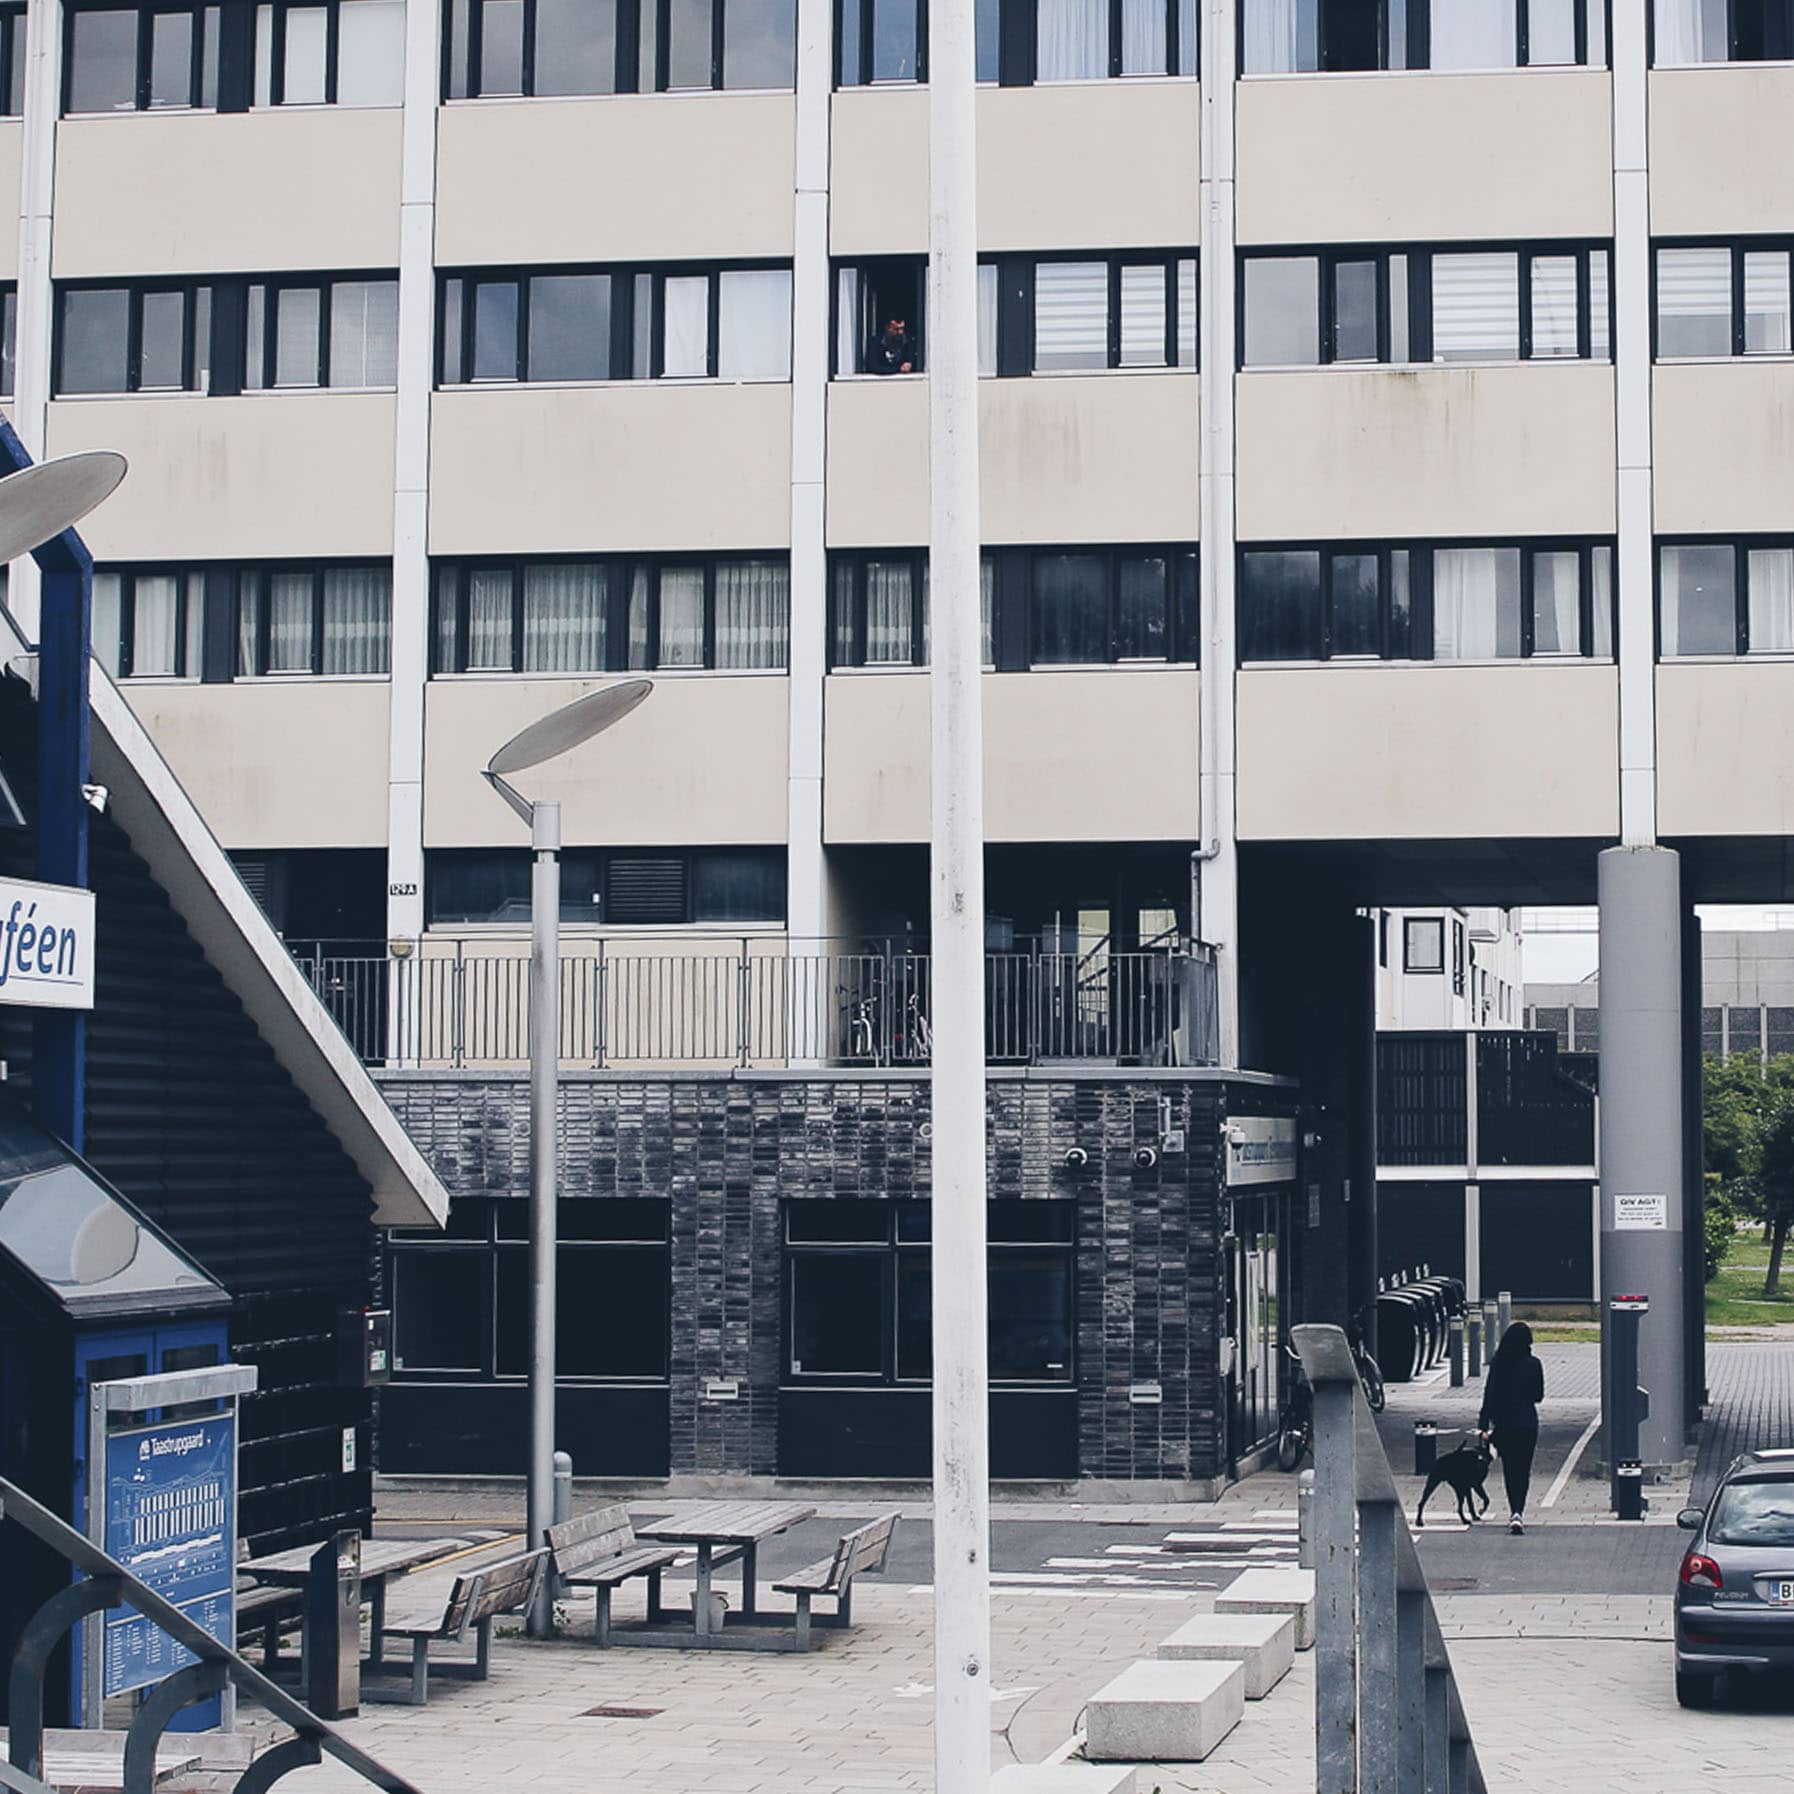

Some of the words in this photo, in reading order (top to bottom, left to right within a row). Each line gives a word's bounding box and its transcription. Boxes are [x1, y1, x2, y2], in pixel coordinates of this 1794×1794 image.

[0, 899, 76, 986] féen
[150, 1428, 204, 1456] Taastrupgaard
[1781, 1583, 1794, 1599] B
